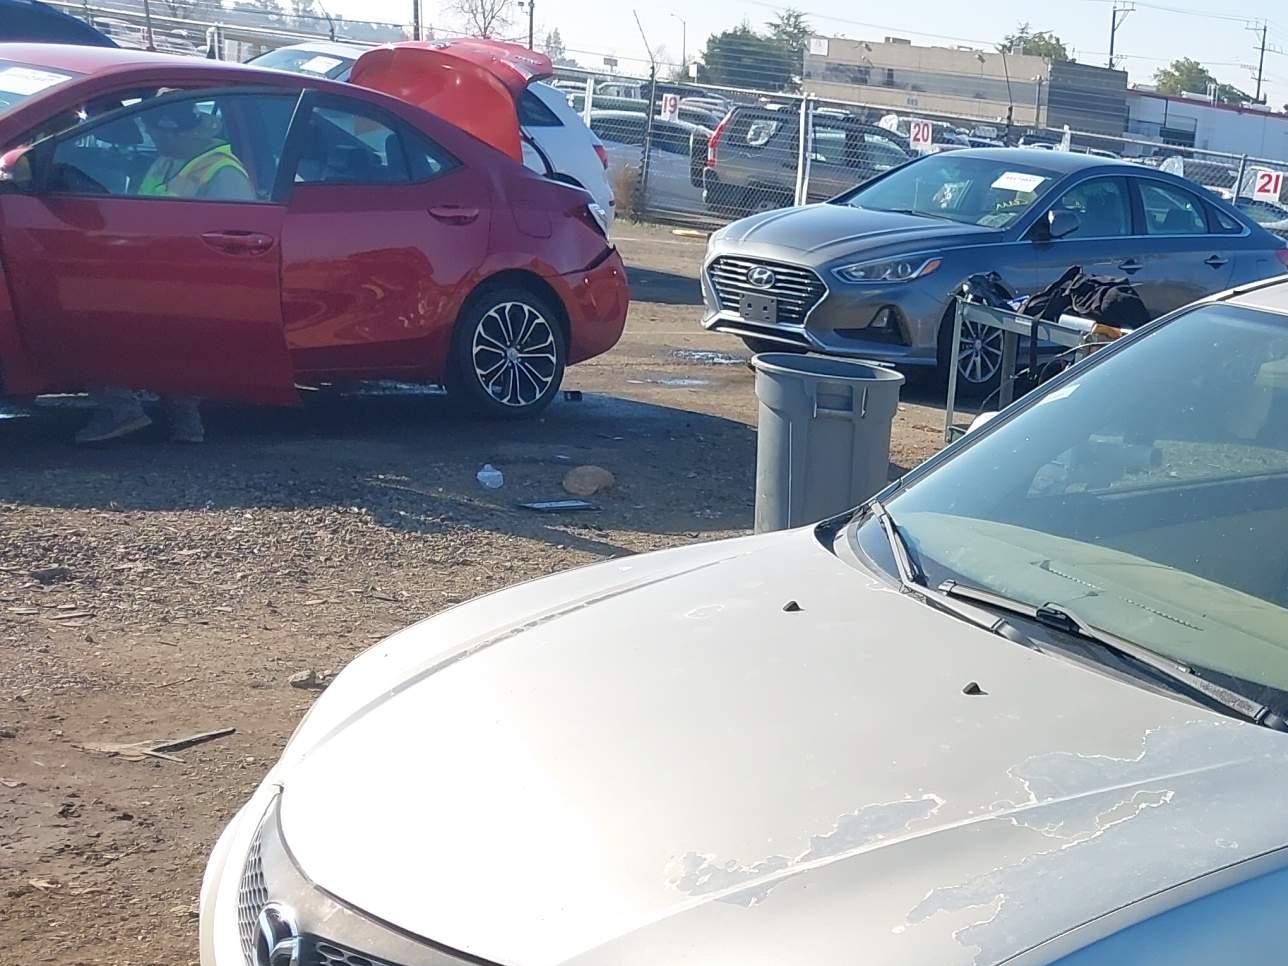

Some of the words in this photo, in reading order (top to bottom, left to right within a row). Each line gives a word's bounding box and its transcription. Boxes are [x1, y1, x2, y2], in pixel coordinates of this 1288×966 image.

[663, 96, 678, 113] 19
[912, 123, 930, 142] 20
[1257, 173, 1281, 194] 21
